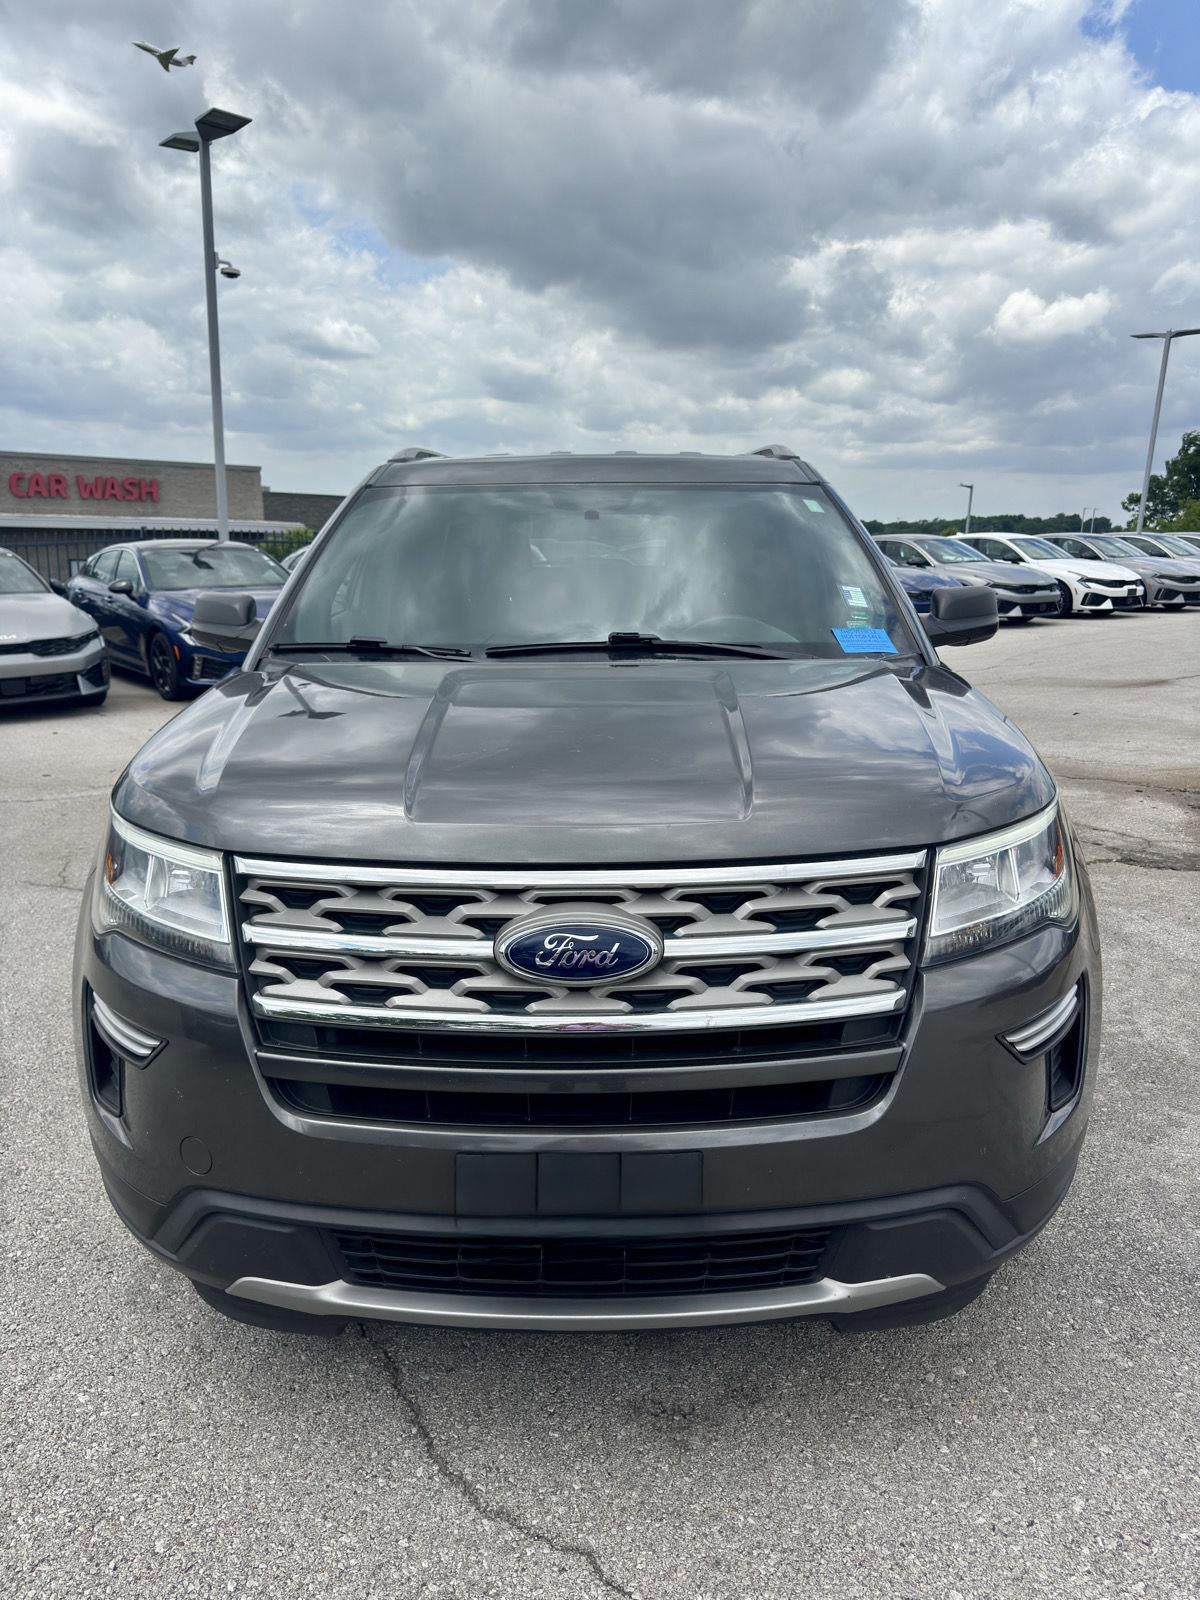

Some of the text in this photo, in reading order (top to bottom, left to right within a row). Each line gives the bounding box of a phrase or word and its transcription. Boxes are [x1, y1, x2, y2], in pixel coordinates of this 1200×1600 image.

[9, 472, 160, 503] CAR WASH
[535, 933, 620, 969] Ford
